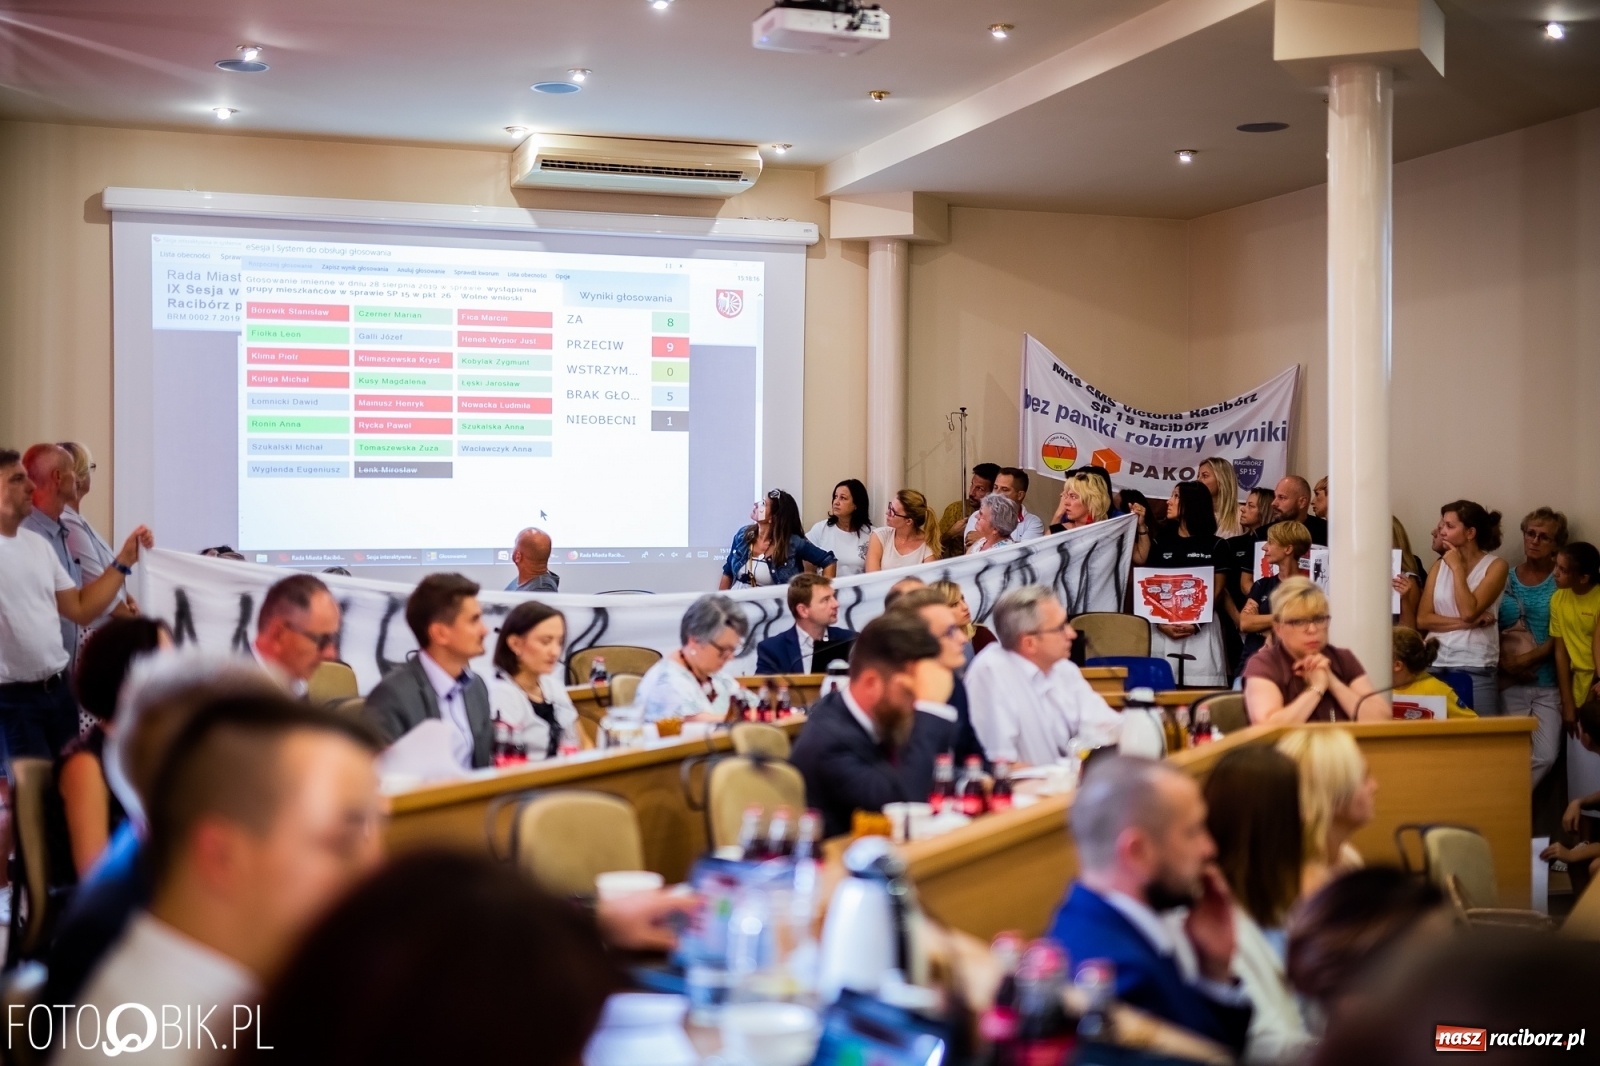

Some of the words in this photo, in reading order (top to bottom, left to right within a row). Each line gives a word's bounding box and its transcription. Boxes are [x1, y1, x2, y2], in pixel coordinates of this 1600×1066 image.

[246, 244, 270, 253] eSesja
[276, 244, 304, 254] System
[319, 247, 347, 256] obsługi
[350, 248, 392, 257] głosowania
[167, 269, 201, 281] Rada
[207, 271, 242, 283] Miast
[246, 275, 298, 284] Głosowanie
[300, 278, 335, 286] imienne
[382, 282, 416, 290] sierpnia
[486, 286, 537, 294] wystąpienia
[167, 284, 180, 294] IX
[186, 284, 223, 297] Sesja
[229, 288, 239, 296] w
[246, 286, 273, 295] grupy
[276, 286, 337, 295] mieszkańców
[349, 289, 384, 298] sprawie
[579, 291, 612, 302] Wyniki
[616, 291, 673, 304] głosowania
[167, 298, 230, 310] Racibórz
[251, 306, 285, 315] Borowik
[288, 308, 329, 316] Stanisław
[358, 310, 391, 318] Czerner
[394, 311, 422, 319] Marian
[461, 313, 478, 322] Fica
[481, 314, 508, 322] Marcin
[567, 314, 583, 324] ZA
[667, 318, 674, 328] 8
[382, 333, 403, 341] Józef
[567, 340, 624, 351] PRZECIW
[667, 342, 674, 353] 9
[251, 352, 275, 360] Klima
[358, 355, 416, 363] Klimaszewska
[419, 356, 440, 365] Kryst
[461, 358, 493, 366] Kobylak
[496, 359, 530, 367] Zygmunt
[667, 367, 674, 377] 0
[251, 375, 278, 383] Kuliga
[358, 377, 378, 386] Kusy
[382, 378, 426, 386] Magdalena
[567, 390, 600, 400] BRAK
[667, 392, 674, 401] 5
[1189, 392, 1259, 419] Racibórz
[567, 414, 637, 426] NIEOBECNI
[1025, 388, 1051, 416] bez
[1055, 403, 1118, 439] paniki
[1124, 431, 1207, 453] robimy
[1214, 420, 1287, 449] wyniki
[1090, 400, 1111, 414] SP
[1116, 411, 1135, 426] 15
[1139, 419, 1210, 432] Racibórz
[666, 417, 673, 426] 1
[461, 445, 509, 453] Wacławczyk
[251, 466, 295, 475] Wyglenda
[297, 466, 340, 475] Eugeniusz
[1129, 461, 1198, 481] PAKO
